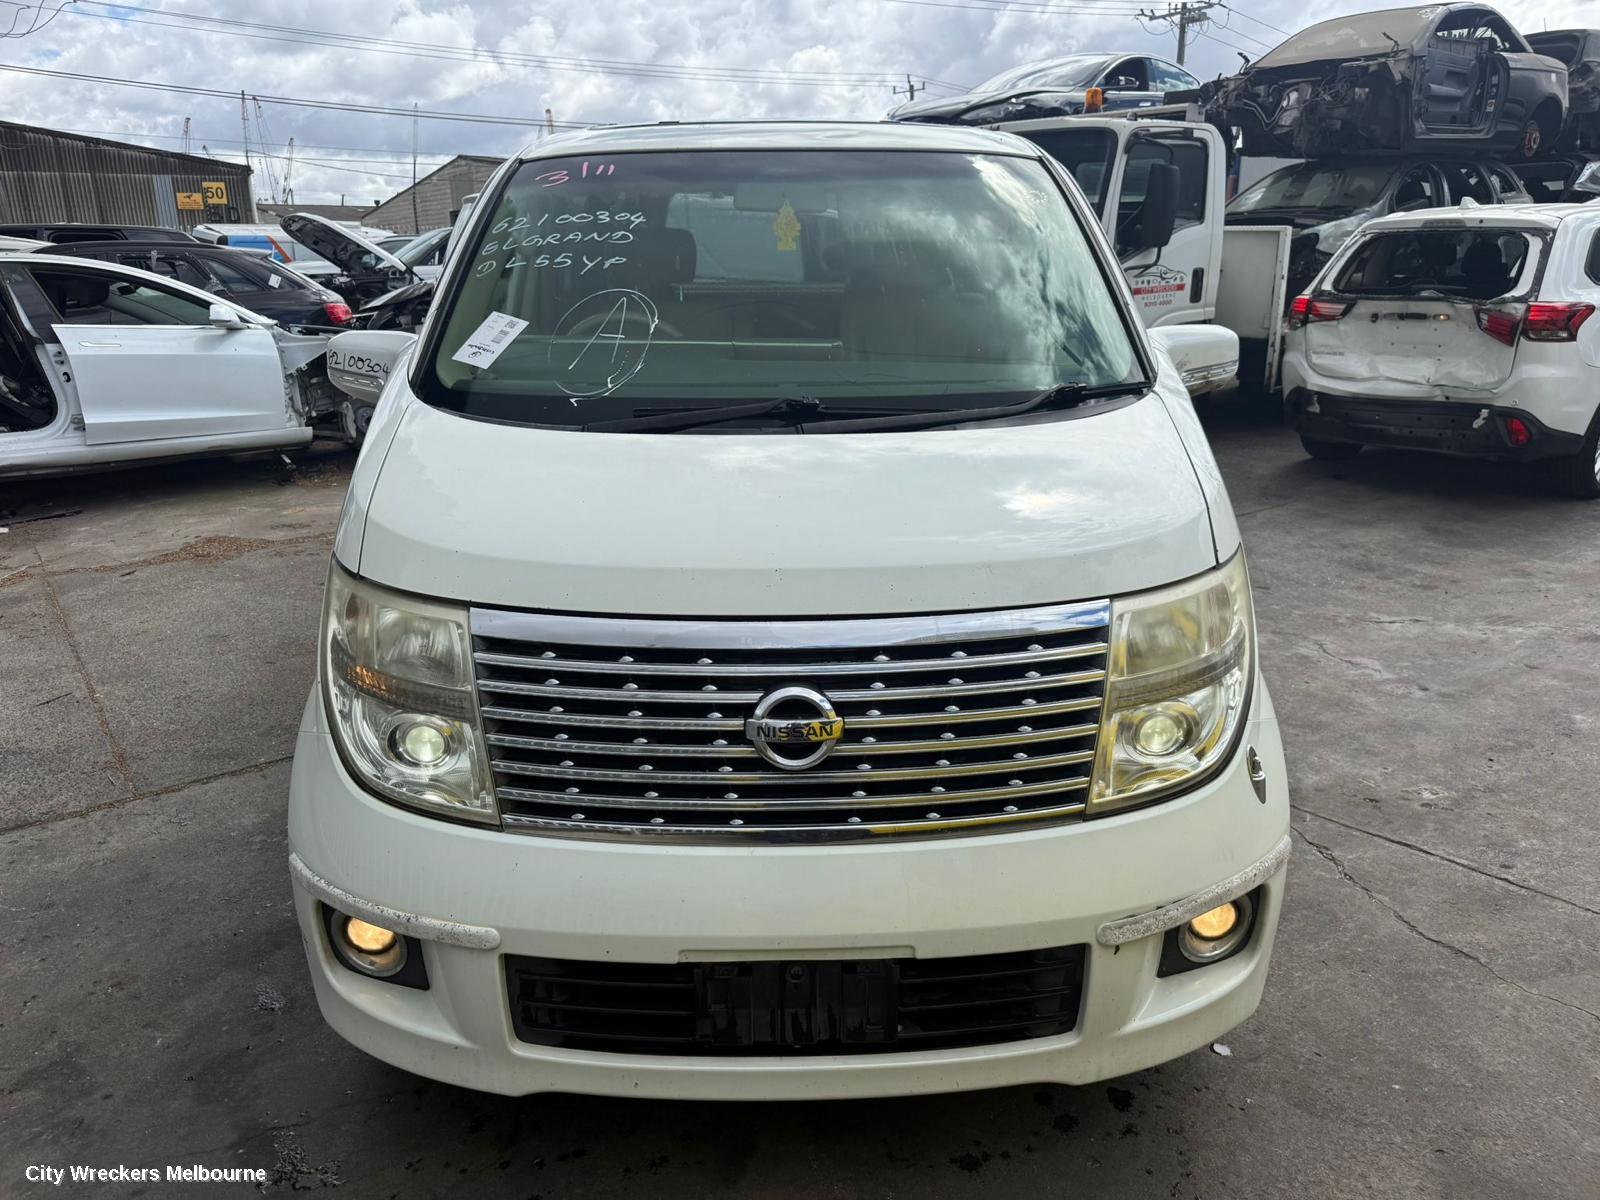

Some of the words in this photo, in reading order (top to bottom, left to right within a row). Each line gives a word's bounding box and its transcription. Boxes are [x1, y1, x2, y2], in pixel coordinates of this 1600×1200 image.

[206, 186, 224, 200] 50
[492, 210, 647, 234] 62100304
[481, 230, 634, 256] ELGRAND
[568, 296, 627, 371] A
[756, 724, 834, 738] NISSAN
